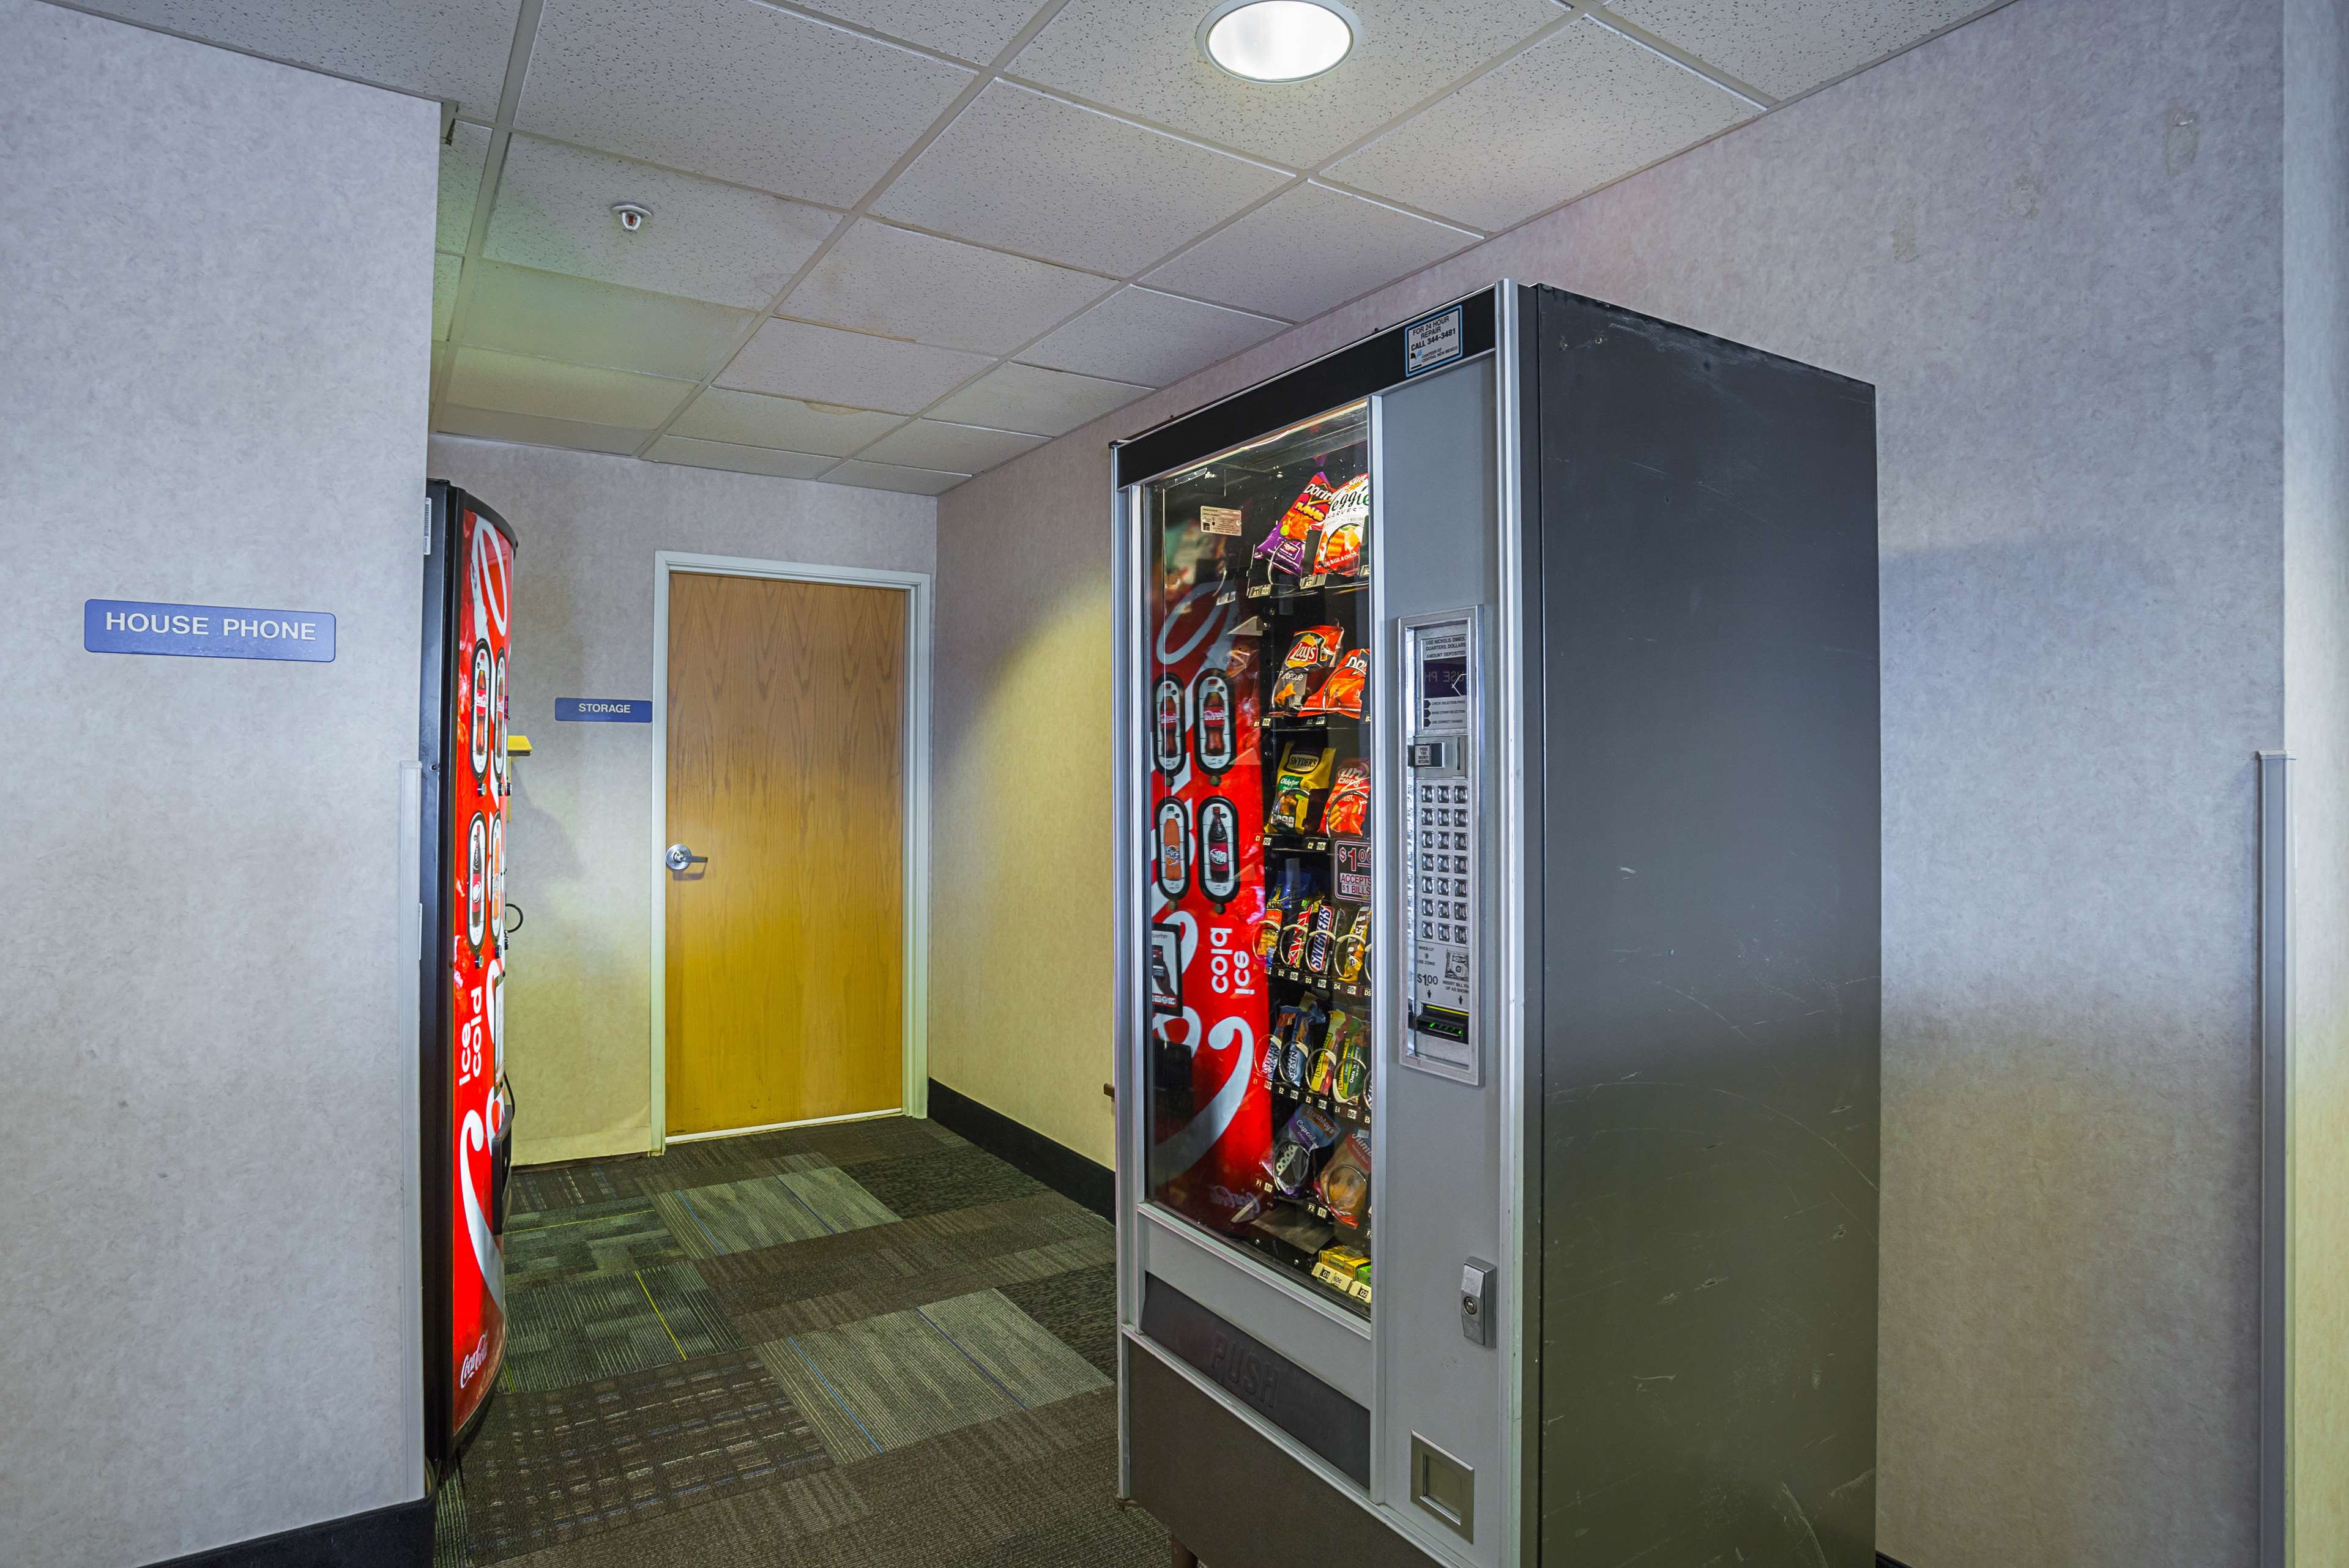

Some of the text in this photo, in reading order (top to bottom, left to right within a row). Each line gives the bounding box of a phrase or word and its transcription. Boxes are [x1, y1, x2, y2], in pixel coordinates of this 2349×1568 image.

[1413, 326, 1424, 336] FOR
[1433, 316, 1450, 327] HOUR
[1421, 326, 1441, 339] REPAIR
[1411, 328, 1456, 351] CALL 344-3481
[106, 612, 316, 641] HOUSE PHONE
[1290, 644, 1316, 661] Lay's
[578, 704, 631, 713] STORAGE
[1341, 874, 1371, 885] ACCEPTS
[1352, 886, 1371, 895] BILLS
[1311, 905, 1331, 969] SNICKERS
[471, 986, 482, 1077] cold
[459, 1022, 471, 1087] ice
[1211, 1331, 1279, 1409] PUSH
